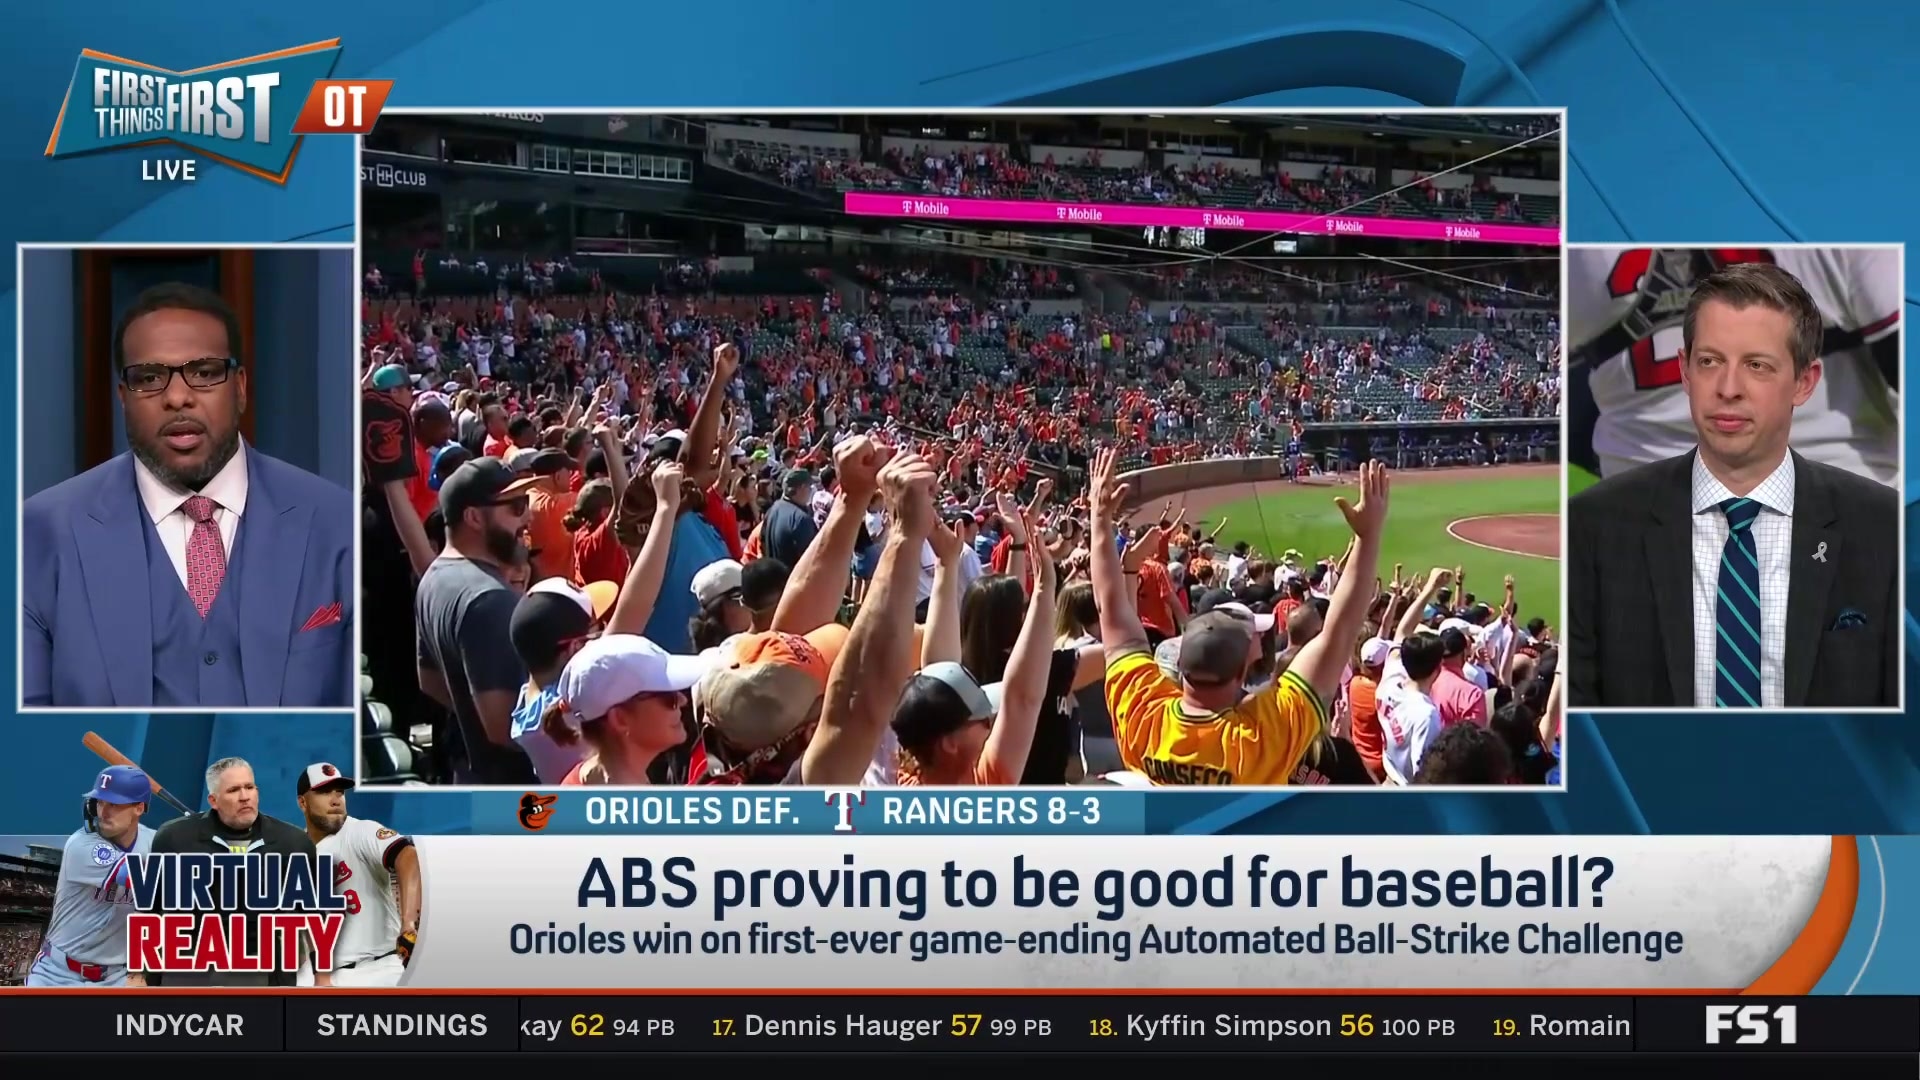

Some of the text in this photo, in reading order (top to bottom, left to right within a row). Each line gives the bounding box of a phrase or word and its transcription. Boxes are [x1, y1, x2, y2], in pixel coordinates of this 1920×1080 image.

[394, 170, 426, 186] CLUB
[914, 200, 949, 215] Mobile
[1068, 207, 1102, 221] Mobile
[100, 773, 112, 789] T
